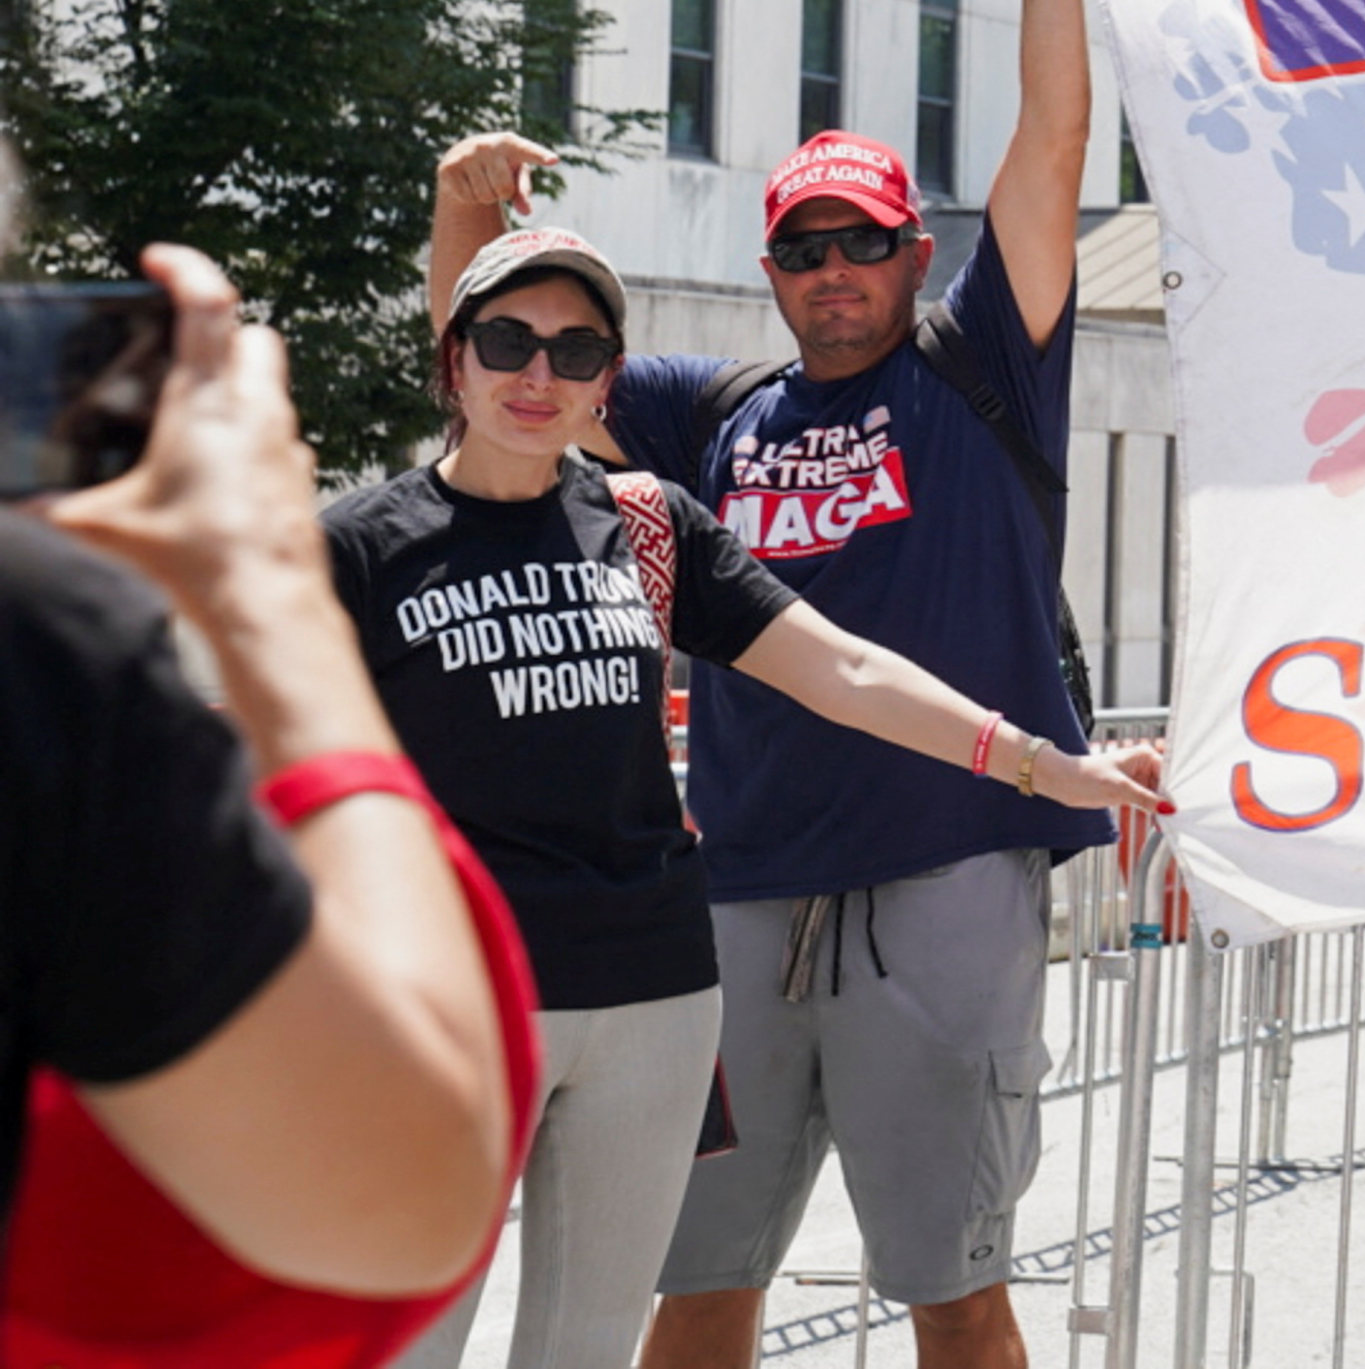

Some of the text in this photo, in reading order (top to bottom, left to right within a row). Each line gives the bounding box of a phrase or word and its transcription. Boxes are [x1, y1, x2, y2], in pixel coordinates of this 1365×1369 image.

[769, 143, 893, 189] MAKE AMERICA
[777, 165, 884, 204] GREAT AGAIN
[733, 431, 888, 487] EXTREME
[723, 463, 906, 549] MAGA
[396, 559, 648, 643] DONALD TRUM
[437, 606, 661, 672] DID NOTHING
[489, 656, 641, 719] WRONG!
